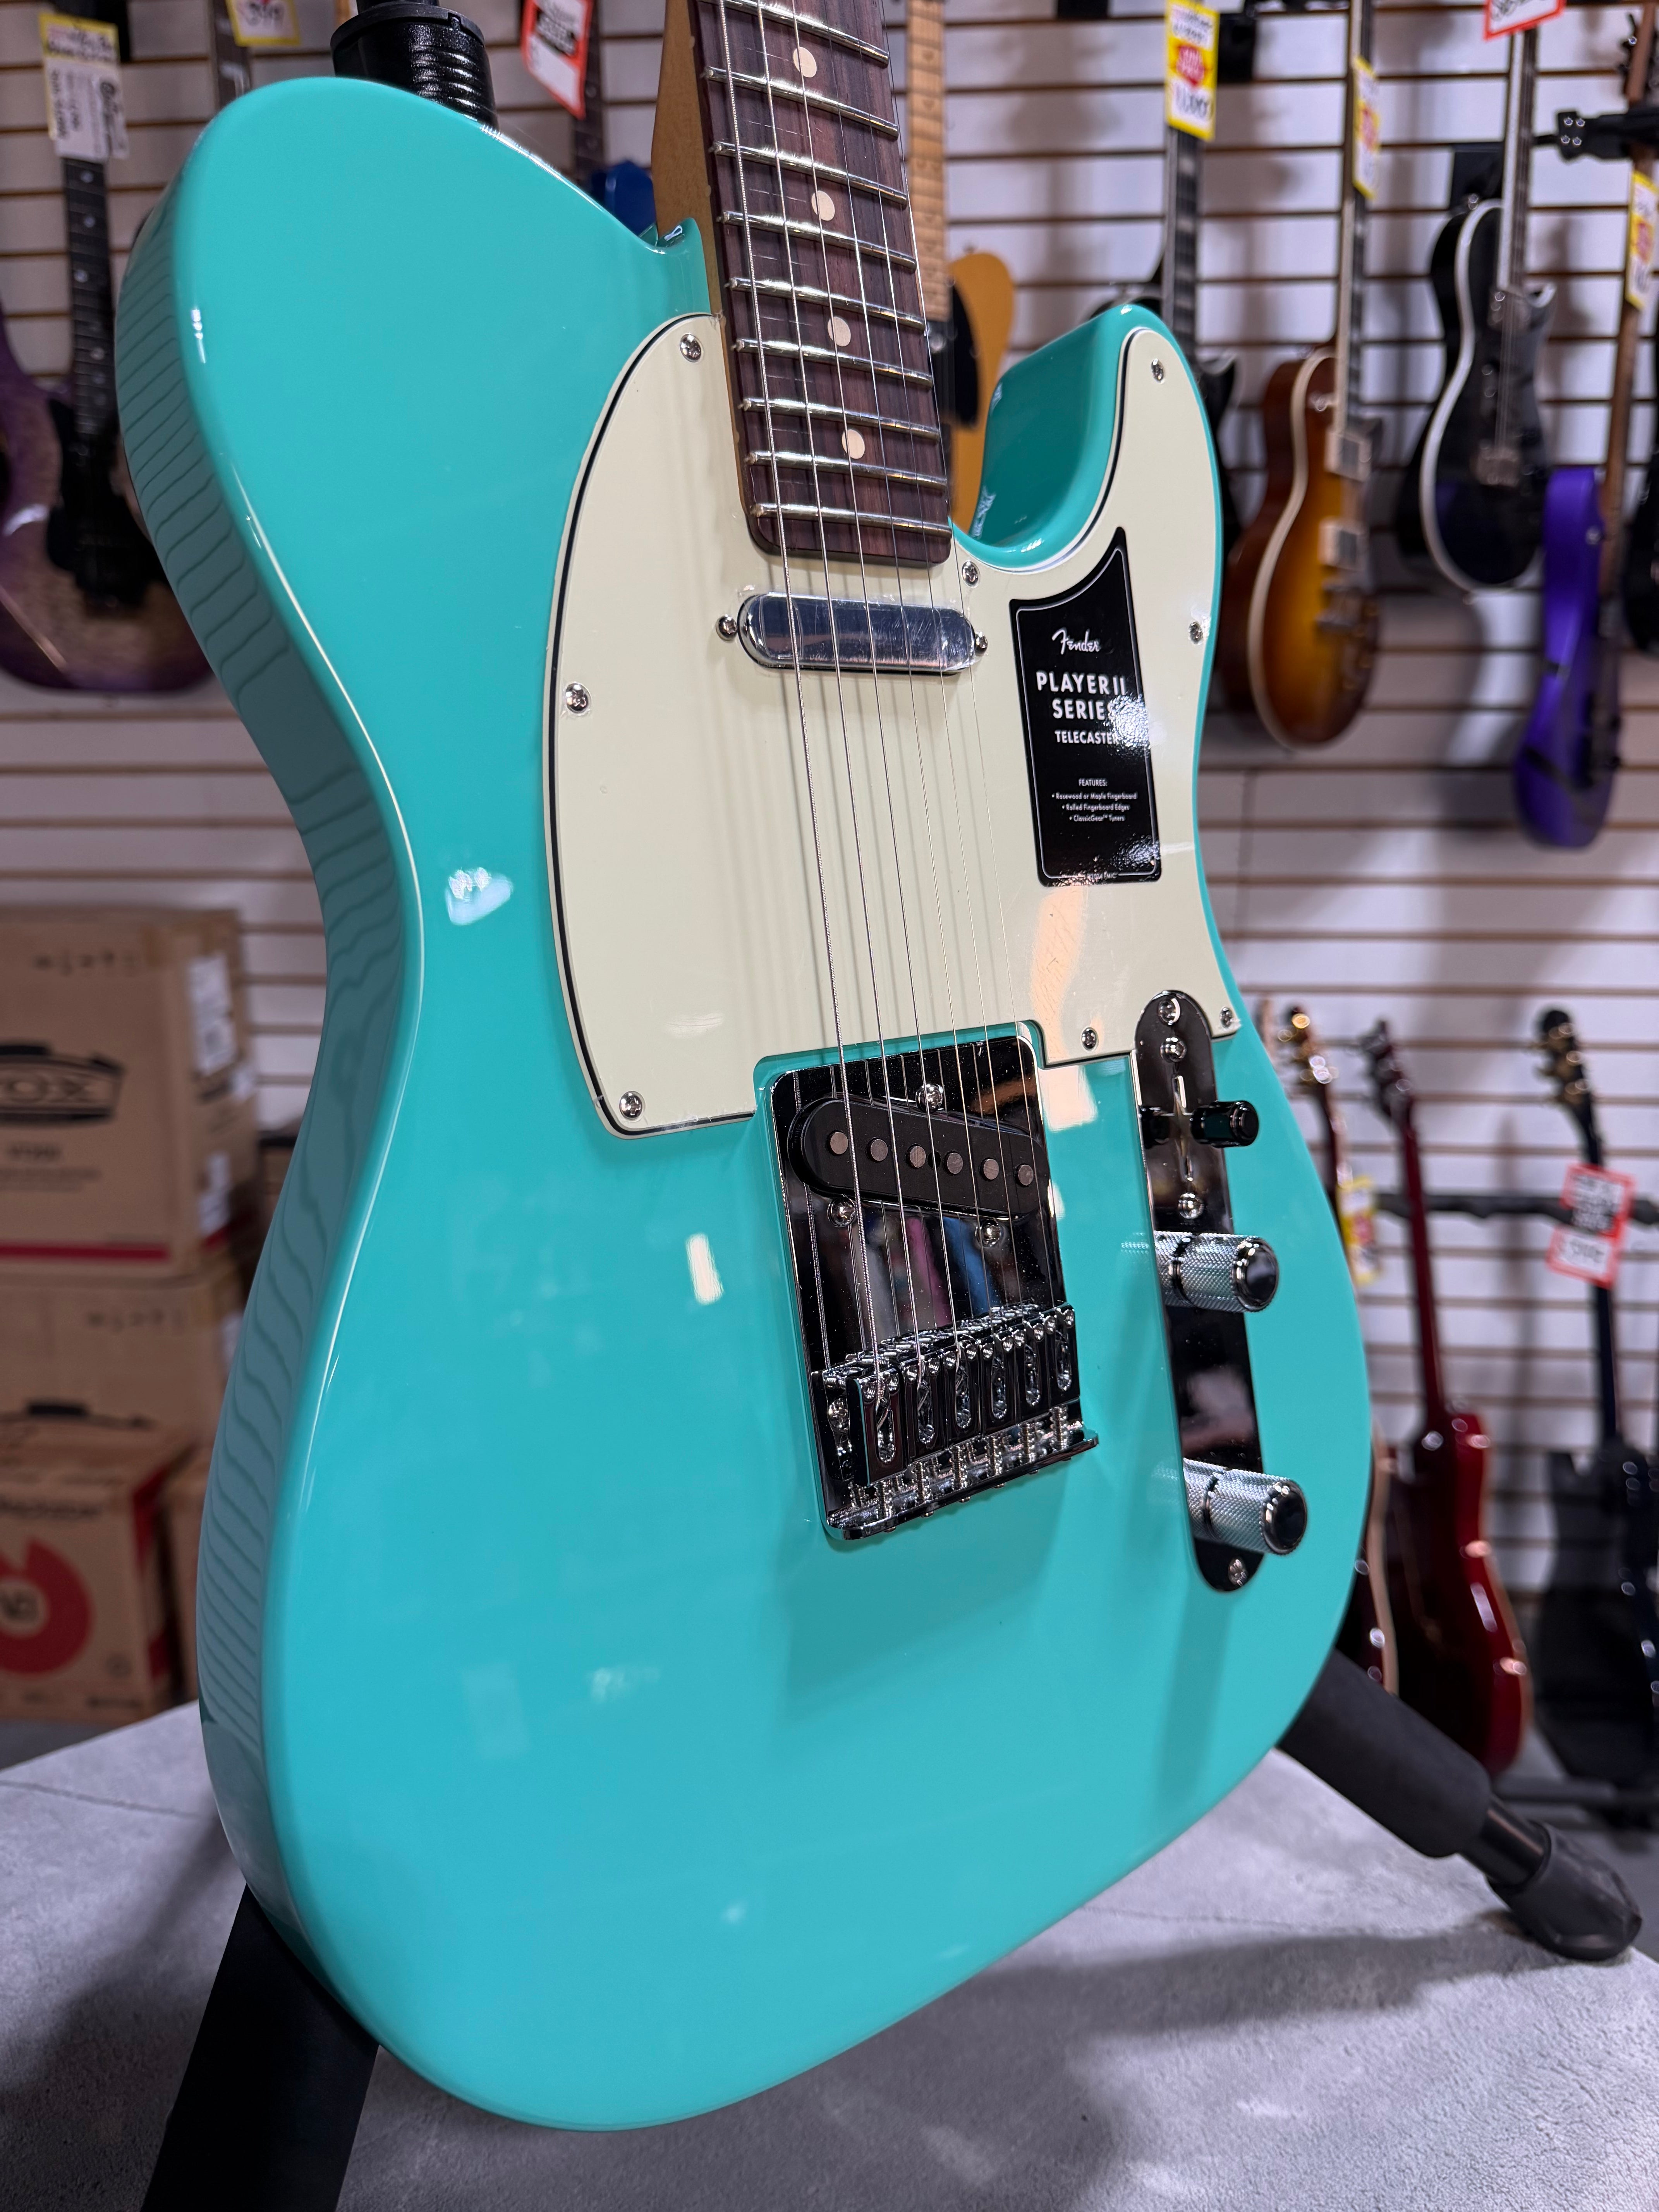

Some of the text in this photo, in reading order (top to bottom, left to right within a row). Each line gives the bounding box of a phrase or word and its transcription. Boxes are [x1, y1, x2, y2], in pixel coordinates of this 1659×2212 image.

[1052, 627, 1101, 654] Fender
[1036, 670, 1109, 695] PLAYER
[1079, 778, 1108, 787] FEATURES:
[1090, 792, 1106, 800] Maple
[1107, 792, 1138, 801] Fingerboard
[1084, 803, 1114, 812] Fingerboard
[1115, 803, 1130, 812] Edges
